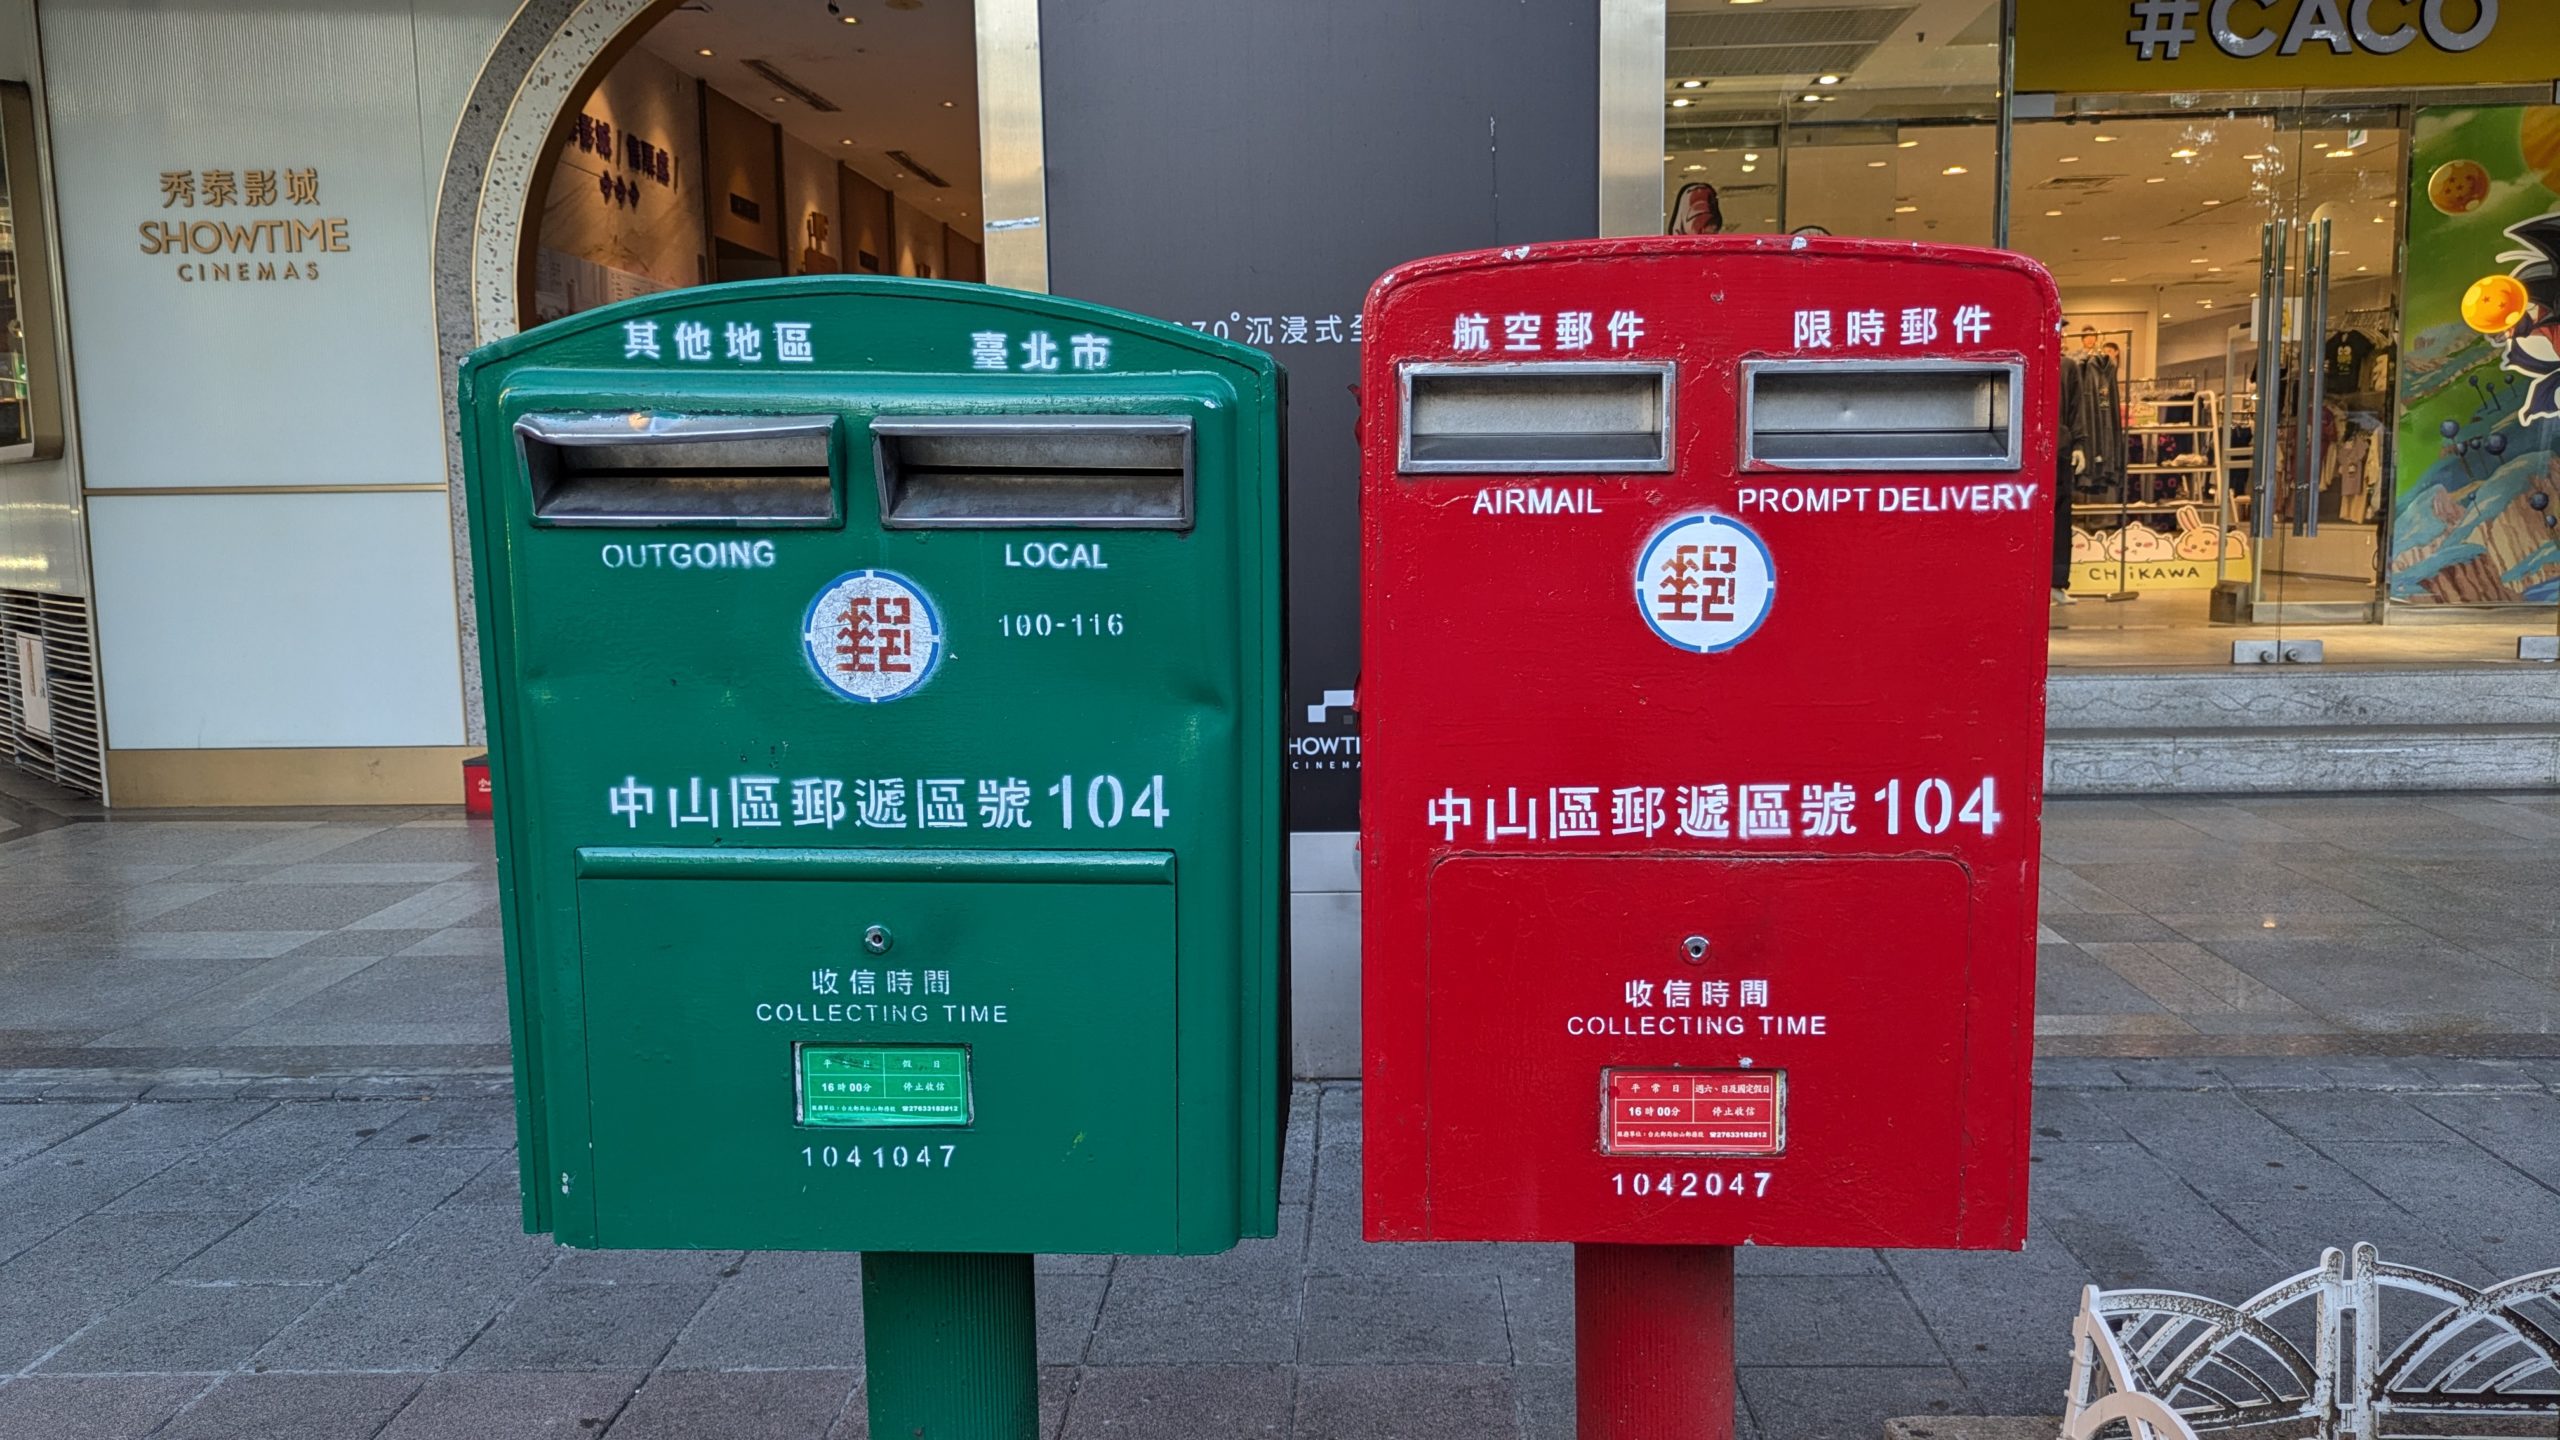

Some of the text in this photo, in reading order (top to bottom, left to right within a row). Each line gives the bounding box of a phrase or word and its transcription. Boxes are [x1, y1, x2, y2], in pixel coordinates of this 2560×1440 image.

[2128, 0, 2500, 60] #CACO
[160, 167, 320, 208] 秀泰影城
[139, 217, 351, 255] SHOWTIME
[178, 262, 321, 283] CINEMAS
[1173, 311, 1362, 344] 70°沉浸式
[1452, 311, 1646, 353] 航空郵件
[1794, 304, 1993, 349] 限時郵件
[623, 321, 814, 363] 其他地區
[971, 332, 1111, 371] 臺北市
[1473, 487, 1604, 515] AIRMAIL
[1738, 483, 2038, 513] PROMPT DELIVERY
[602, 540, 776, 569] OUTGOING
[1004, 541, 1109, 569] LOCAL
[998, 613, 1125, 637] 100-116
[1293, 761, 1361, 769] CINEMA
[609, 774, 1171, 829] 中山區郵遞區號 104
[1428, 776, 2003, 841] 中山區郵遞區號 104
[811, 968, 951, 996] 收信時間
[1624, 979, 1769, 1009] 收信時間
[756, 1003, 1009, 1023] COLLECTING TIME
[1567, 1015, 1827, 1036] COLLECTING TIME
[903, 1082, 945, 1092] 停止收信
[1631, 1083, 1680, 1093] 平常日
[1712, 1106, 1755, 1117] 停止收信
[800, 1144, 956, 1169] 1041047
[1611, 1172, 1773, 1199] 1042047
